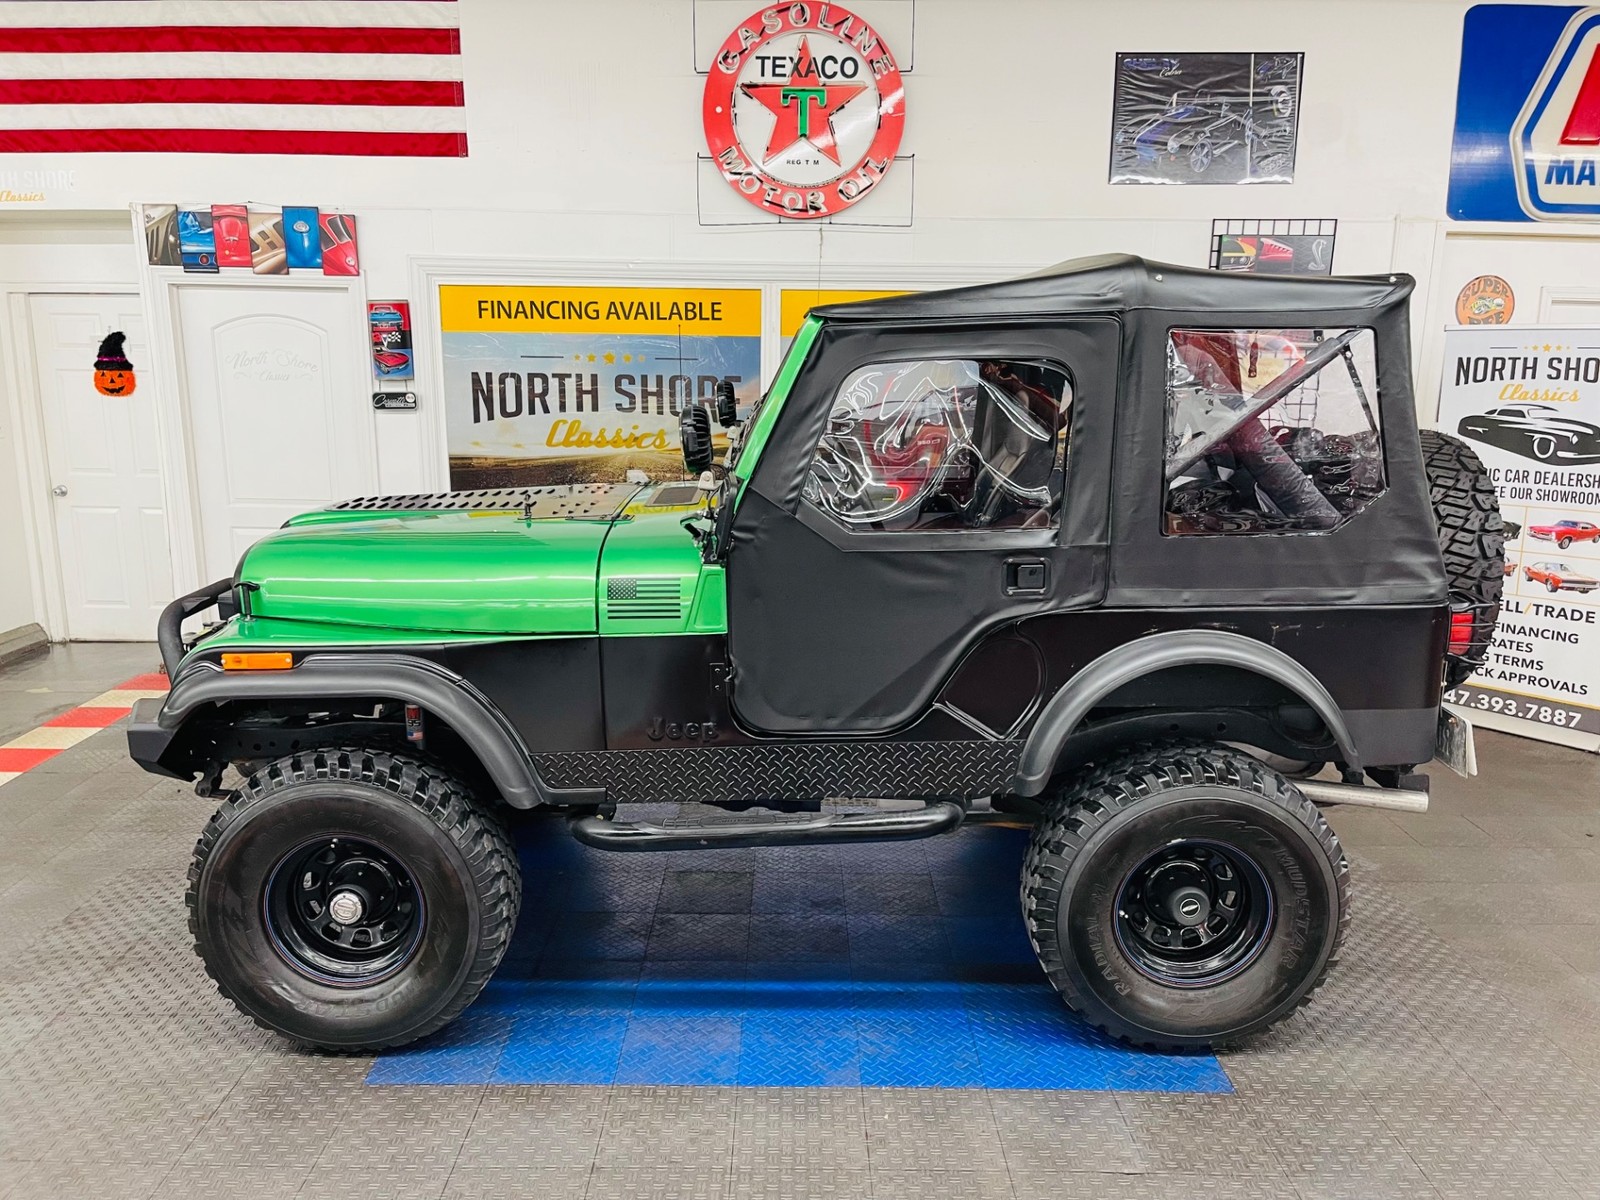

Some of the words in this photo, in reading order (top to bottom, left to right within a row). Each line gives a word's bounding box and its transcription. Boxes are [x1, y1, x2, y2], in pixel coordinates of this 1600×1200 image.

[718, 3, 896, 81] GASOLINE
[755, 55, 860, 79] TEXACO
[780, 87, 828, 139] T
[23, 170, 77, 192] SHORE
[718, 146, 828, 216] MOTOR
[837, 156, 890, 200] OIL
[1462, 278, 1509, 311] SUPER
[477, 299, 600, 320] FINANCING
[605, 301, 723, 322] AVAILABLE
[225, 350, 269, 369] North
[271, 348, 319, 373] Shore
[1455, 357, 1538, 386] NORTH
[470, 371, 599, 424] NORTH
[1498, 383, 1581, 402] Classics
[545, 419, 671, 450] Classics
[1504, 469, 1530, 484] CAR
[1509, 486, 1533, 500] OUR
[1490, 637, 1534, 653] RATES
[1494, 621, 1580, 645] FINANCING
[1493, 653, 1545, 671] TERMS
[1497, 670, 1589, 696] APPROVALS
[647, 716, 720, 742] Jeep
